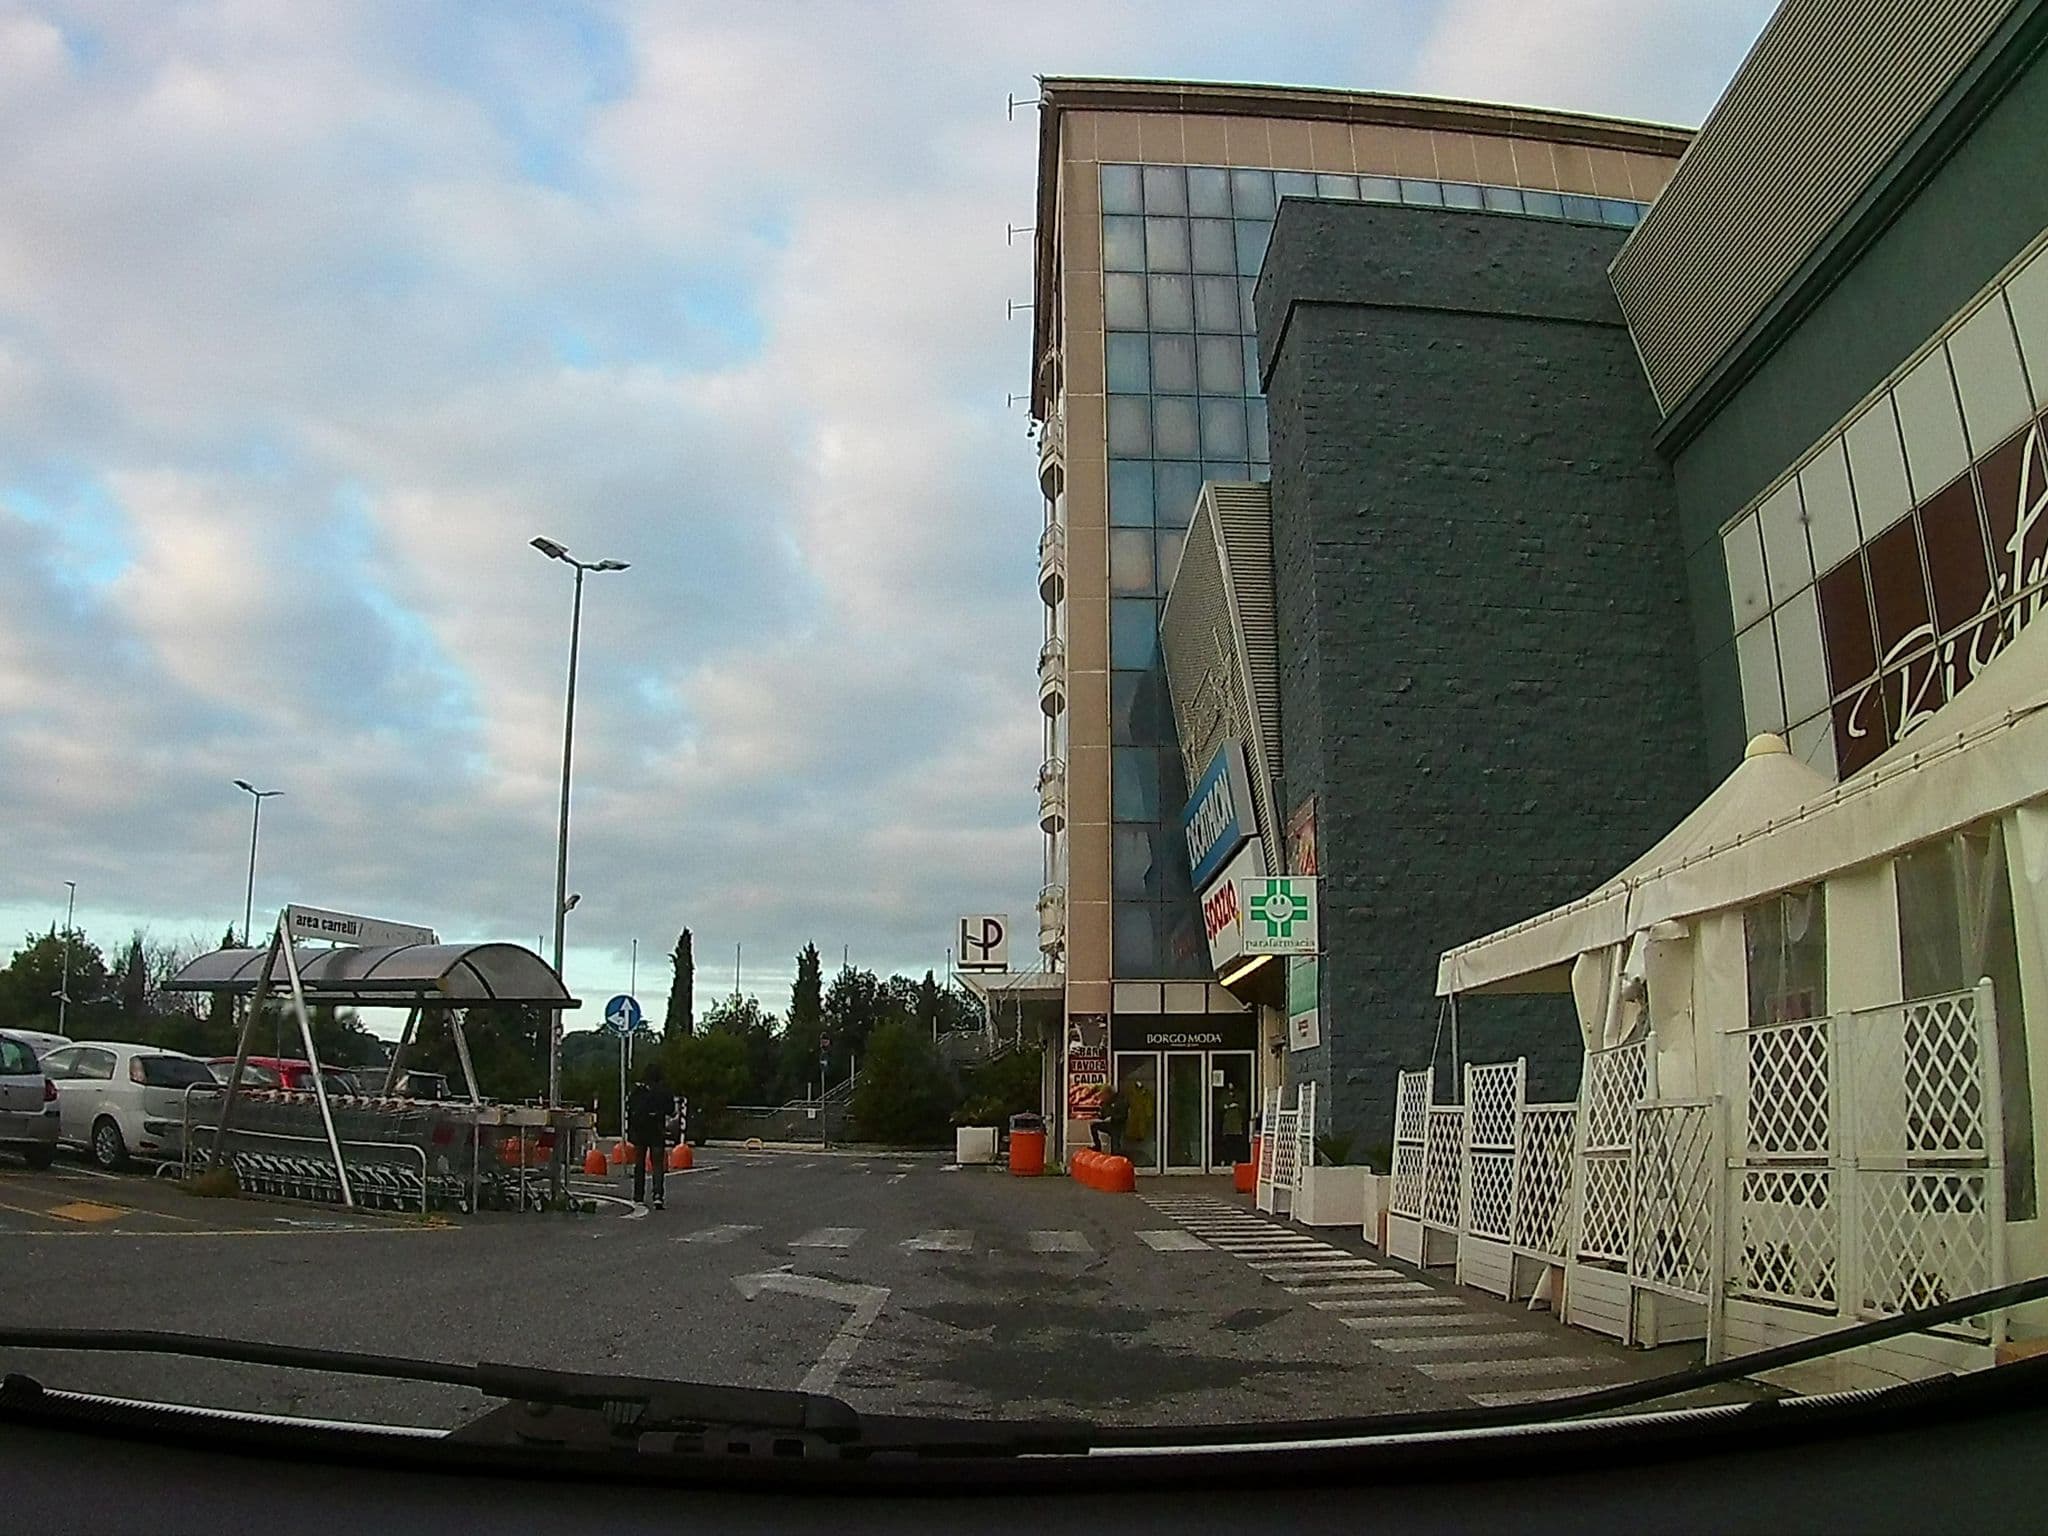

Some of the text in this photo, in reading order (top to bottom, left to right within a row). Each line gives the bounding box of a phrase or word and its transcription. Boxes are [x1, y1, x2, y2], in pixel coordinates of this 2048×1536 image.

[1185, 767, 1234, 871] DECATHLON
[296, 914, 319, 929] area
[321, 918, 357, 936] carrelli
[1245, 937, 1316, 951] parafarmacia
[1146, 1033, 1222, 1044] BORGO MODA
[1072, 1060, 1106, 1071] TAVOLA
[1074, 1073, 1105, 1084] CALDA
